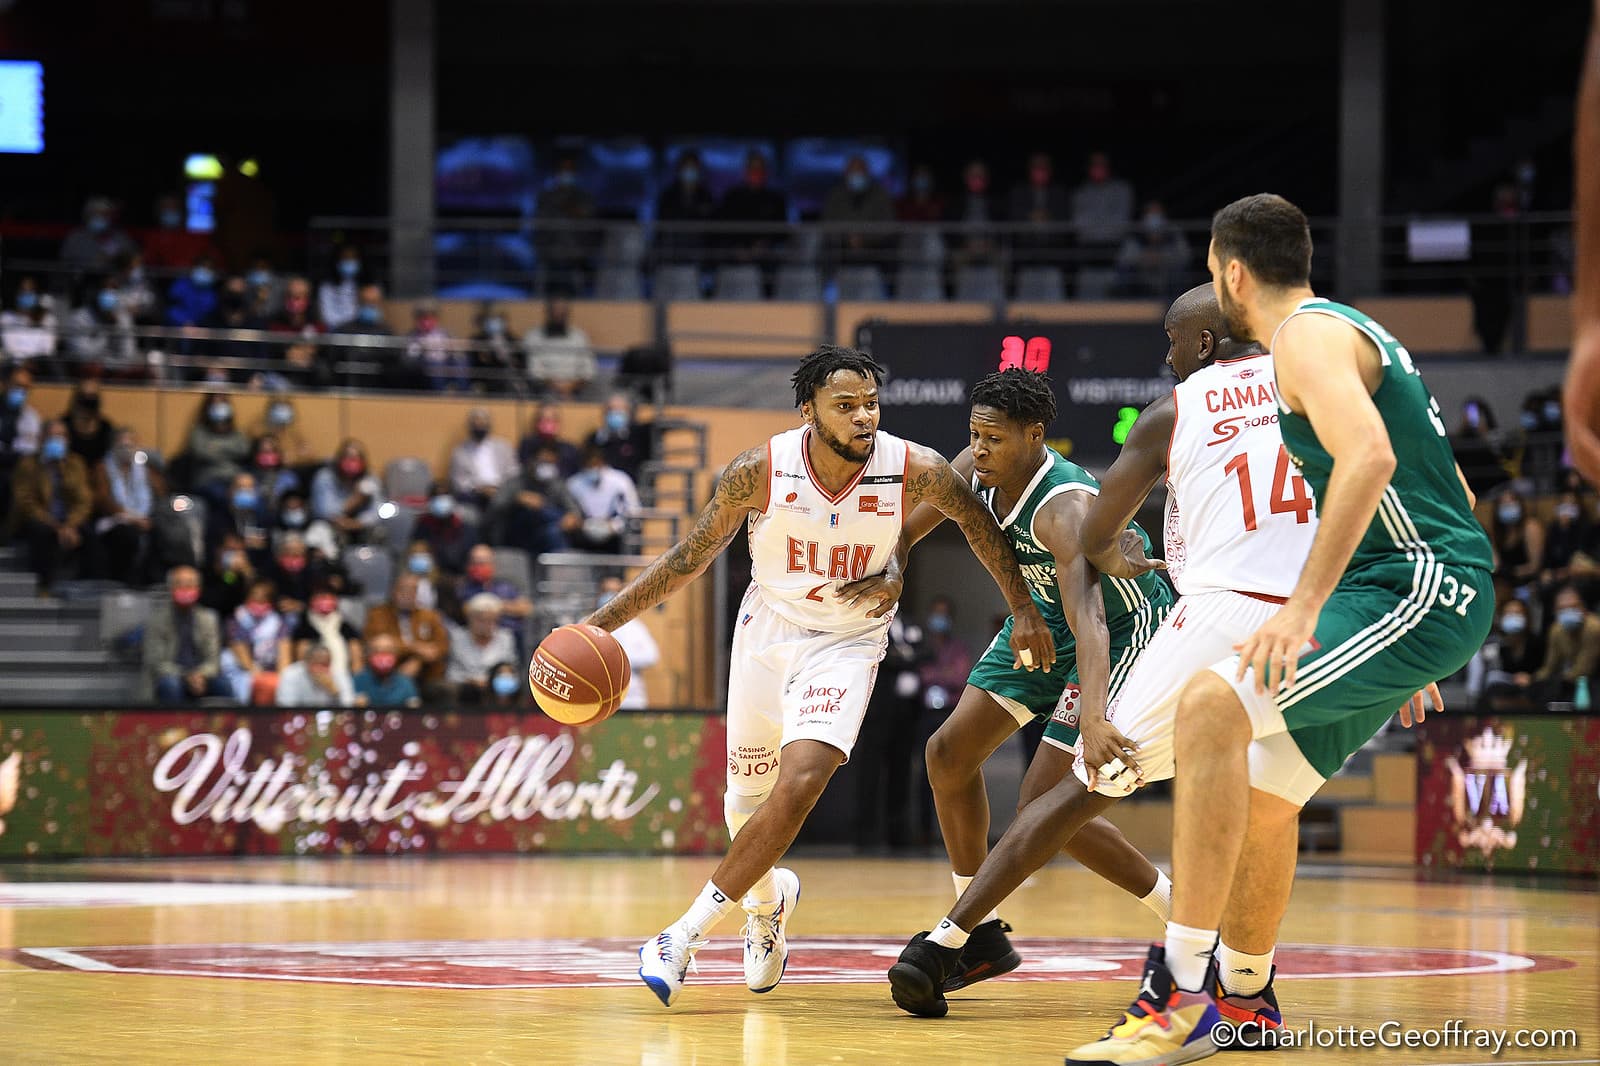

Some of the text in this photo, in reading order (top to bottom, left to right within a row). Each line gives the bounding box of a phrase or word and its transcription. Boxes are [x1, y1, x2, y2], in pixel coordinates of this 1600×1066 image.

[1205, 381, 1277, 413] CAMA
[1224, 443, 1313, 532] 14
[786, 535, 875, 581] ELAN
[1439, 576, 1477, 617] 37
[802, 684, 848, 700] dracy
[799, 699, 841, 717] santé
[738, 750, 775, 760] SANTENAY
[743, 756, 779, 777] JOA
